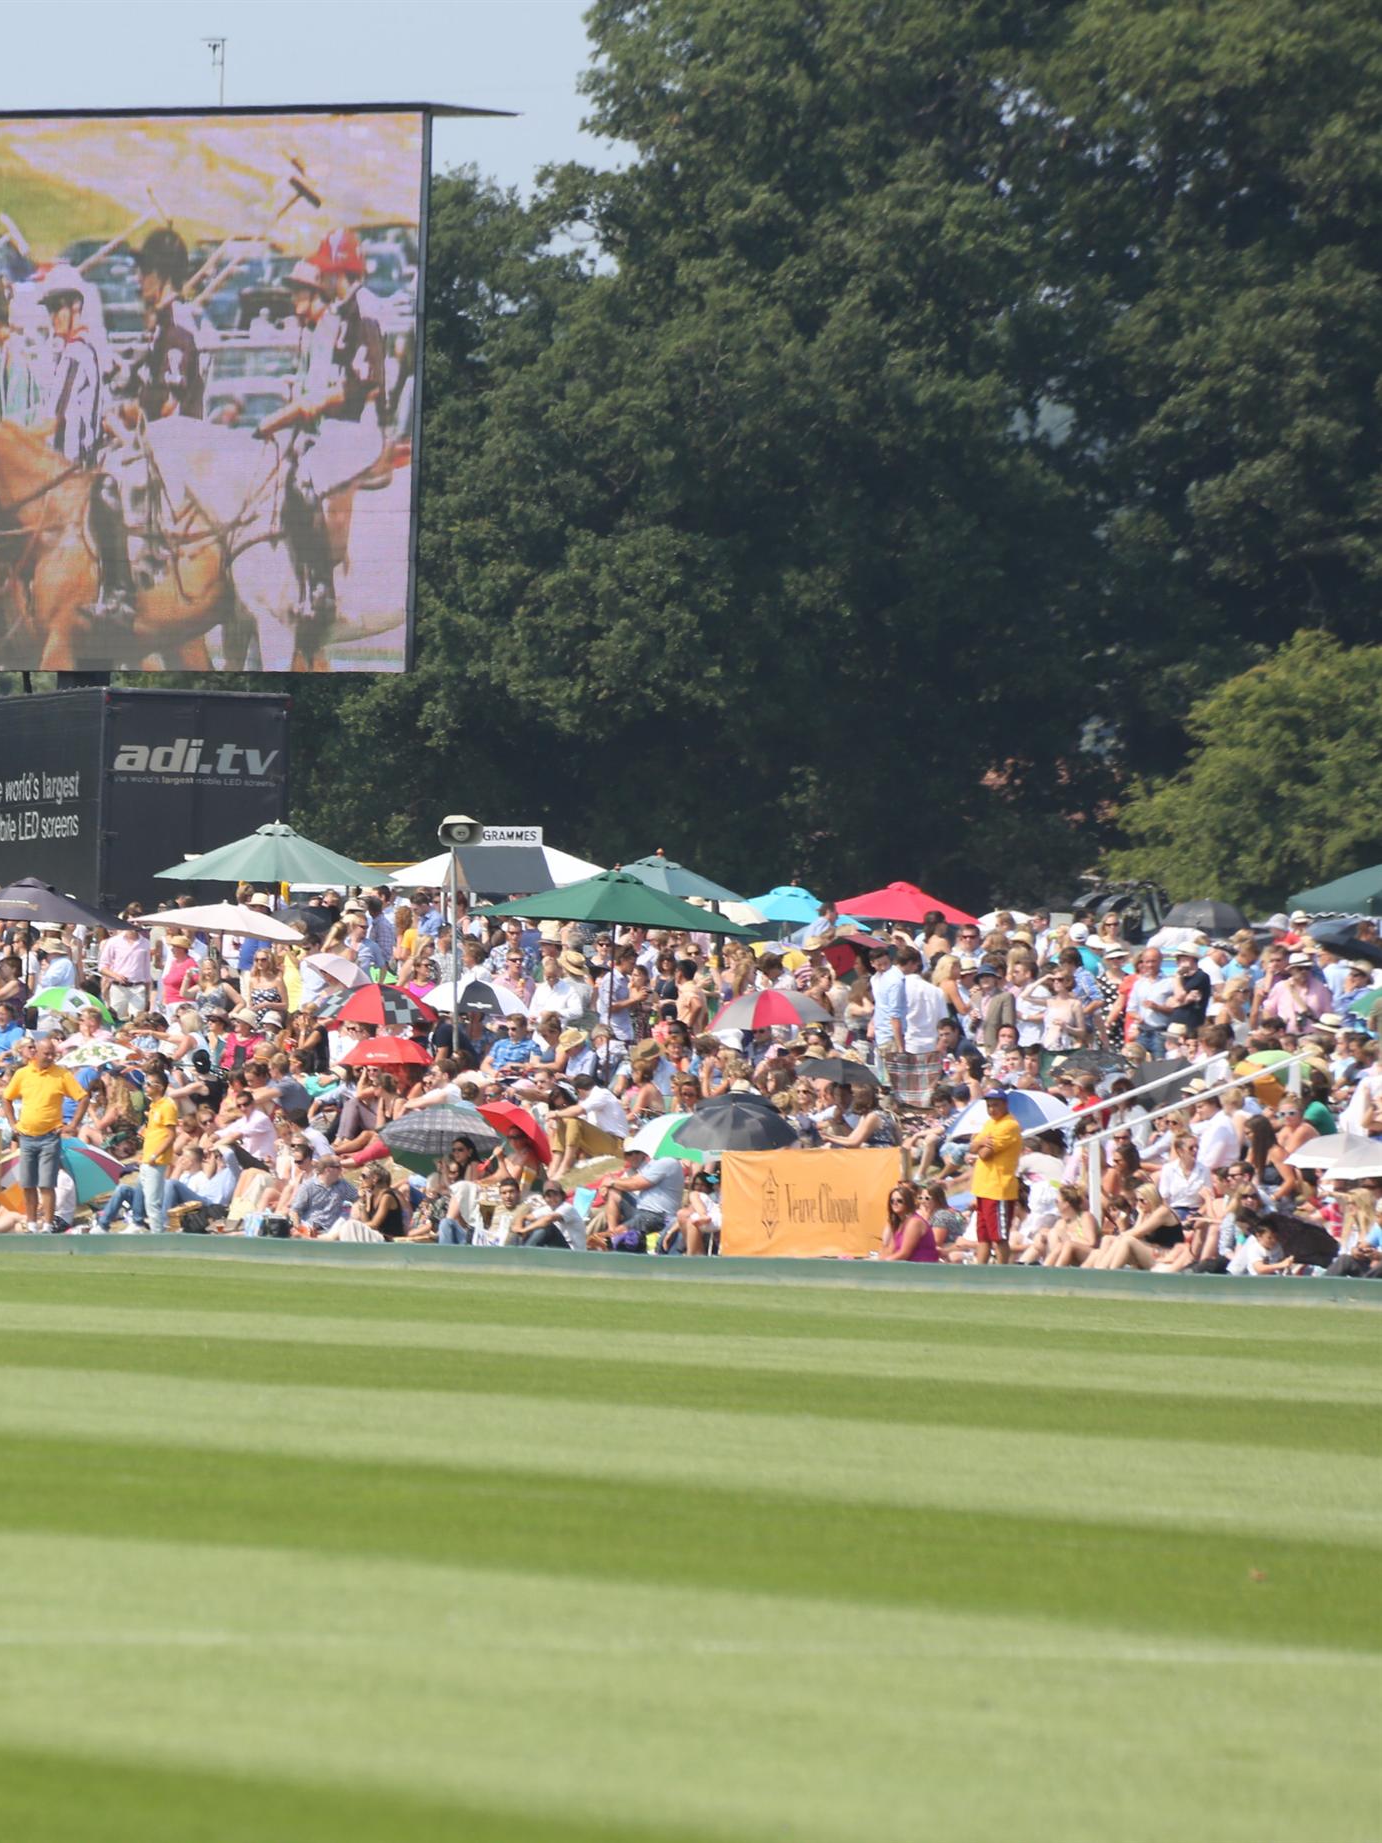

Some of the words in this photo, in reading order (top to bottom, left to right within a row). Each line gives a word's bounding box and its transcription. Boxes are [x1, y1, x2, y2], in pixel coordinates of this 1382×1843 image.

[114, 738, 279, 775] adi.tv
[5, 772, 39, 803] world's
[42, 771, 80, 805] largest
[162, 776, 193, 786] largest
[224, 778, 241, 786] LED
[18, 811, 39, 840] LED
[41, 814, 79, 840] screens
[483, 830, 537, 841] GRAMMES
[785, 1183, 817, 1223] Veuve
[819, 1183, 860, 1232] Clicquot
